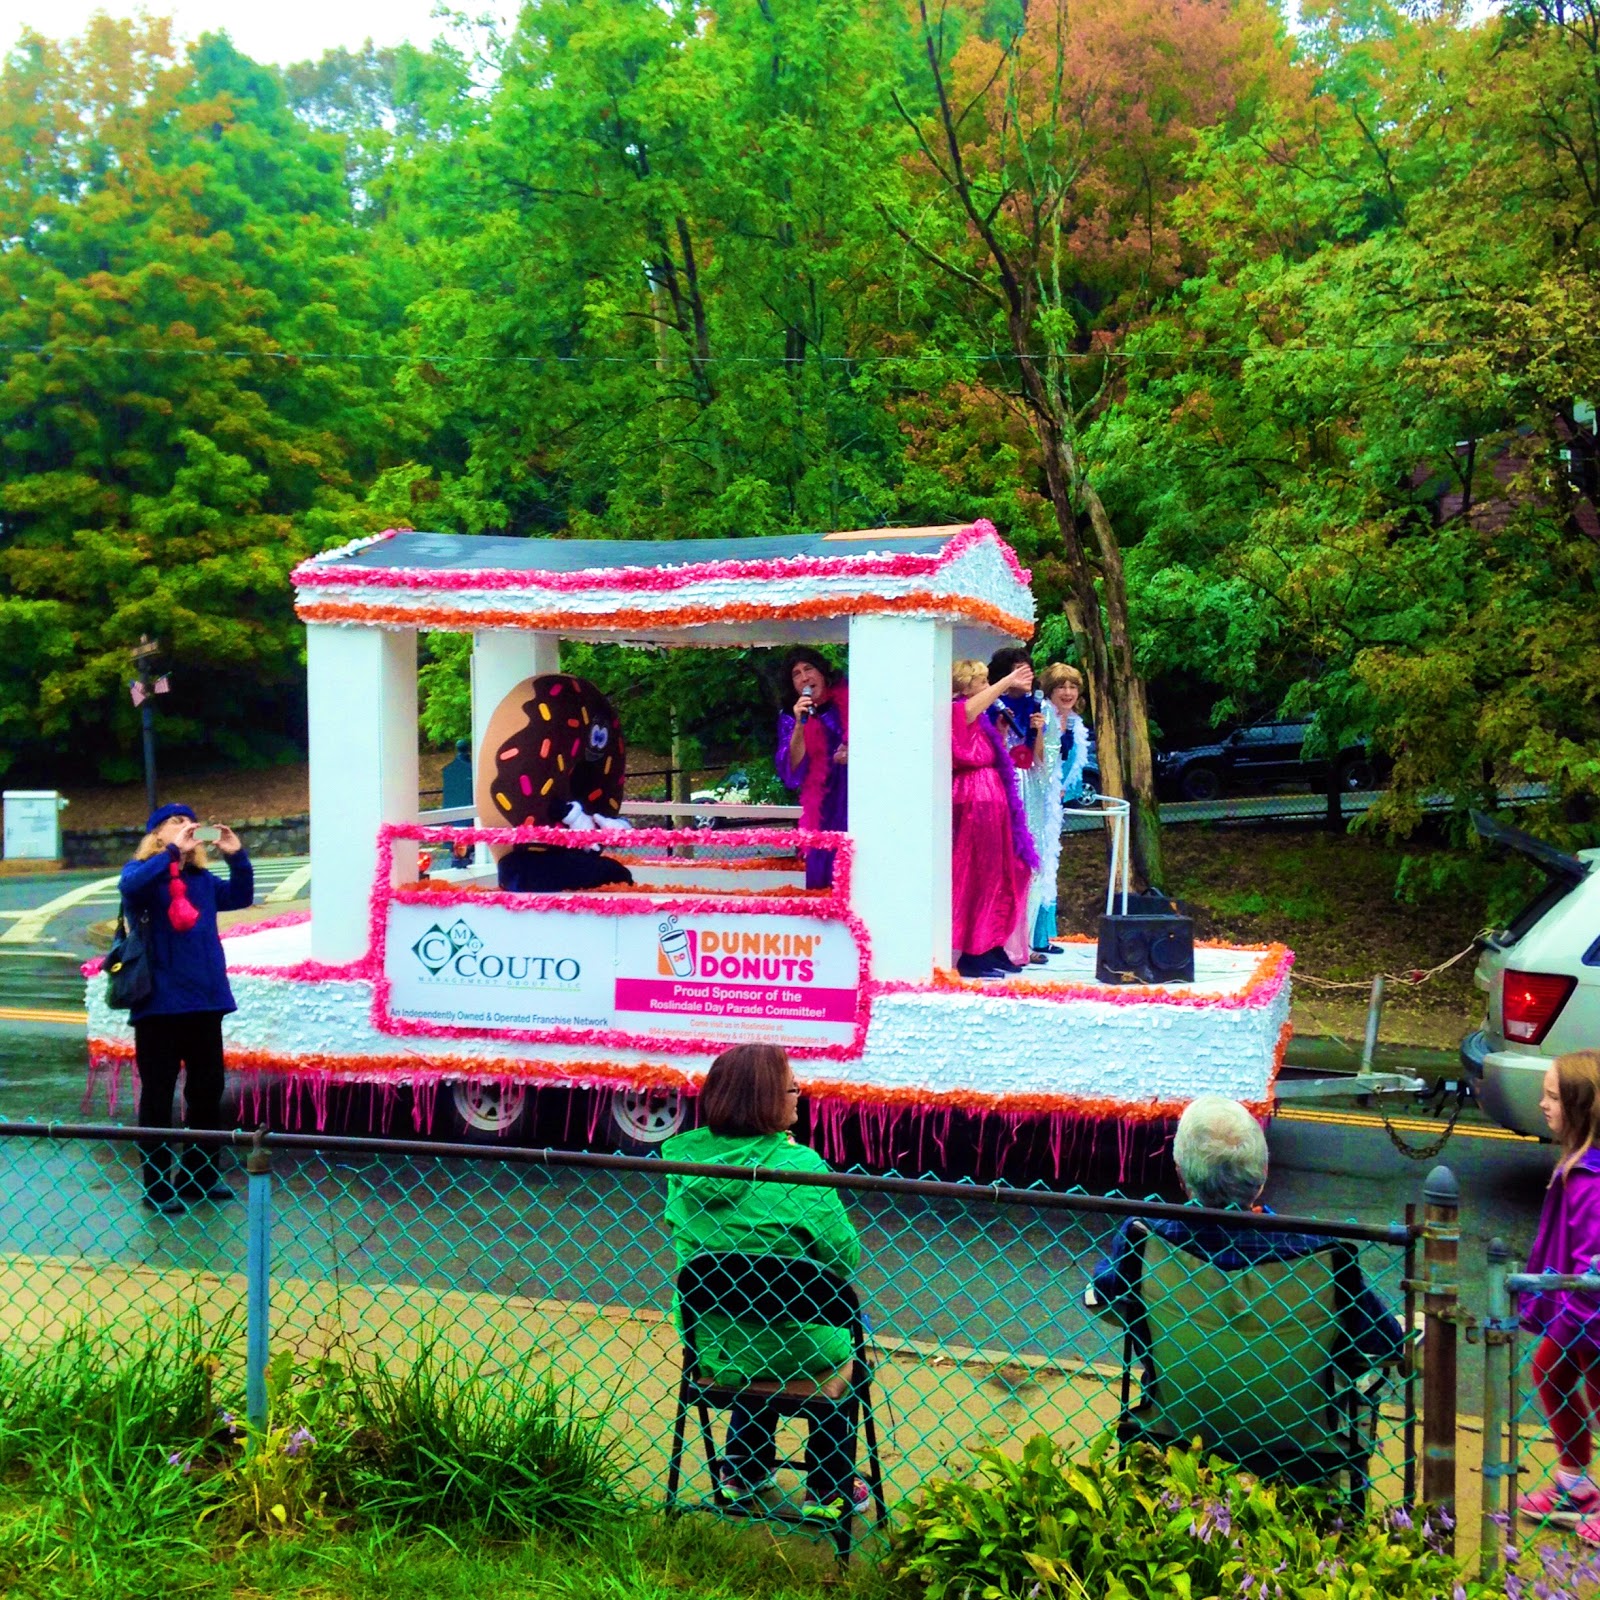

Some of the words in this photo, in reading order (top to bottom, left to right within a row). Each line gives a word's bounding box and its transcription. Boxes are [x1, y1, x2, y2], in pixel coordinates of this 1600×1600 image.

[454, 929, 467, 940] M
[701, 930, 821, 957] DUNKIN'
[423, 938, 446, 961] C
[455, 954, 581, 982] COUTO
[701, 956, 814, 983] DONUTS
[674, 985, 709, 997] Proud
[712, 987, 762, 1001] Sponsor
[765, 990, 778, 1001] of
[782, 991, 802, 1002] the
[402, 1009, 455, 1020] Independently
[457, 1011, 484, 1020] Owned
[486, 1012, 492, 1020] &
[494, 1013, 530, 1023] Operated
[532, 1014, 571, 1024] Franchise
[573, 1016, 608, 1026] Network
[650, 999, 702, 1011] Roslindale
[704, 1002, 724, 1014] Day
[726, 1003, 763, 1014] Parade
[765, 1005, 826, 1017] Committee!
